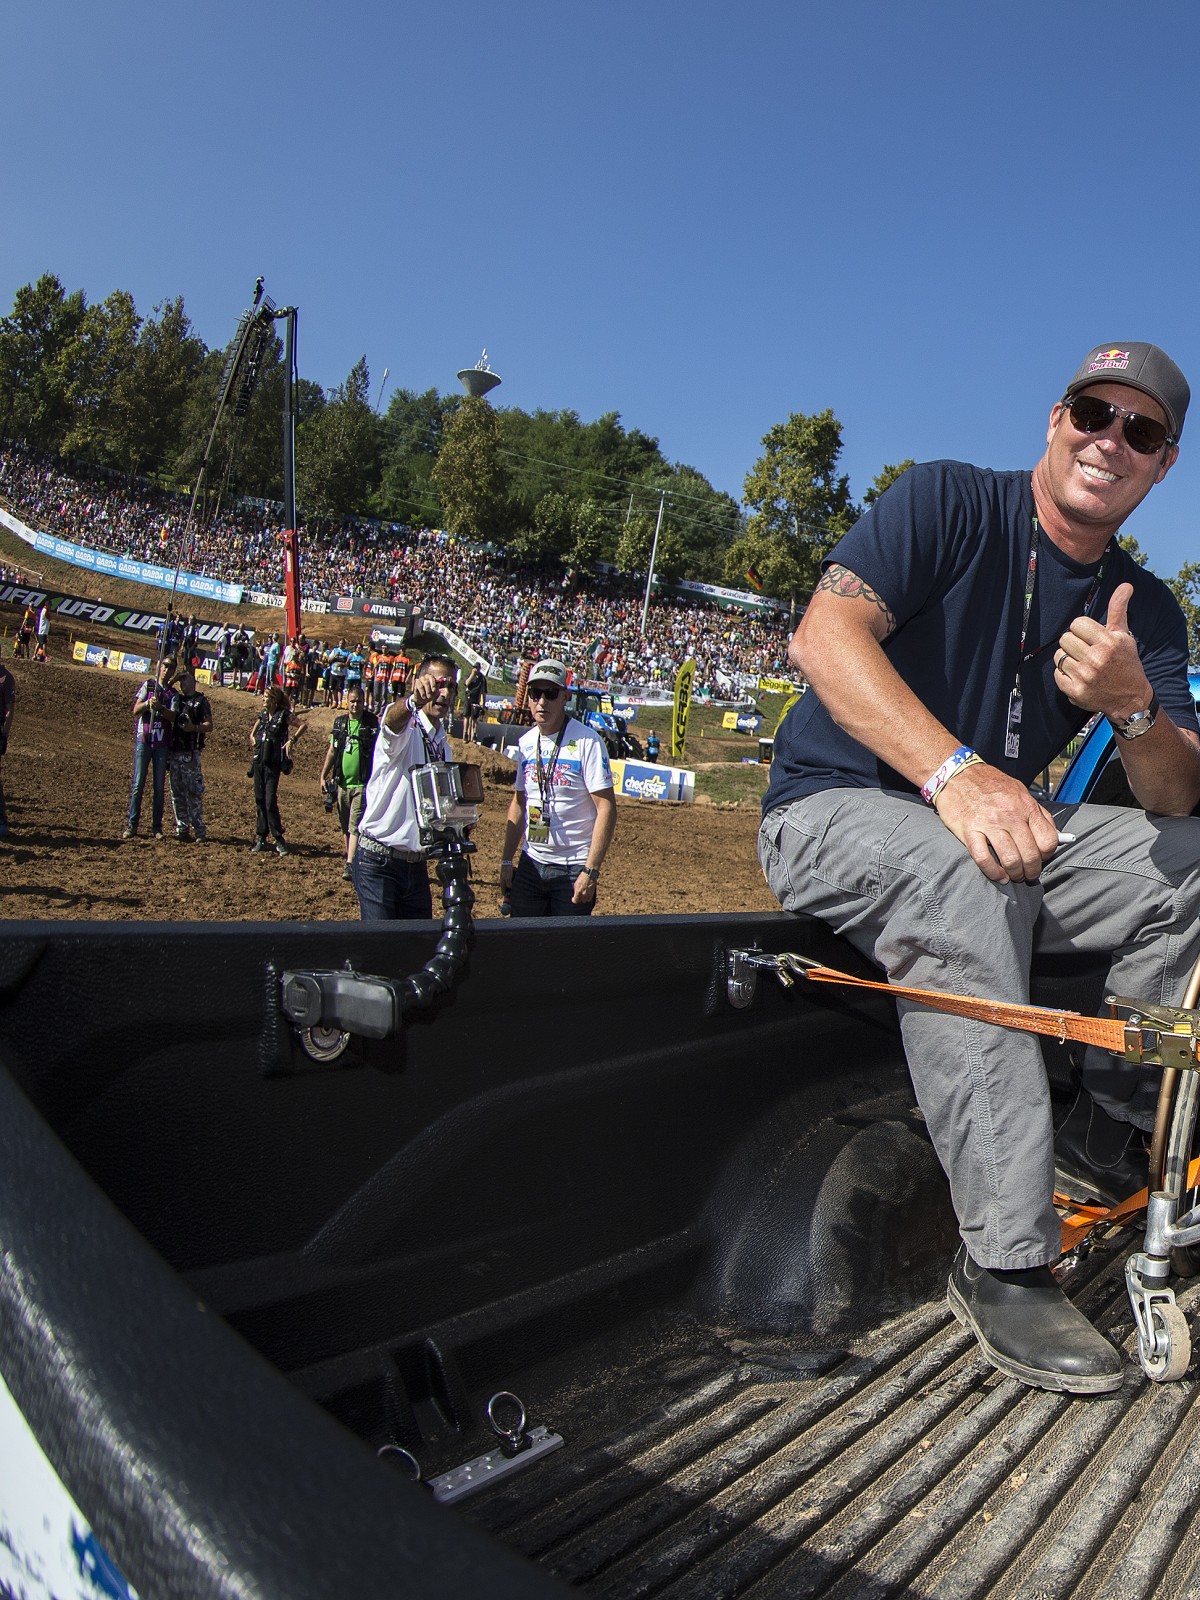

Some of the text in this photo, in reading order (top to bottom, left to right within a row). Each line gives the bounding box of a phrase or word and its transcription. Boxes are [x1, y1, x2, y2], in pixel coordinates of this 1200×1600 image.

[1106, 360, 1129, 370] Bull
[190, 579, 214, 592] GARDA
[261, 596, 283, 606] DAVID
[57, 598, 116, 622] UFO
[370, 604, 397, 617] ATHENA
[624, 775, 667, 795] checkstar
